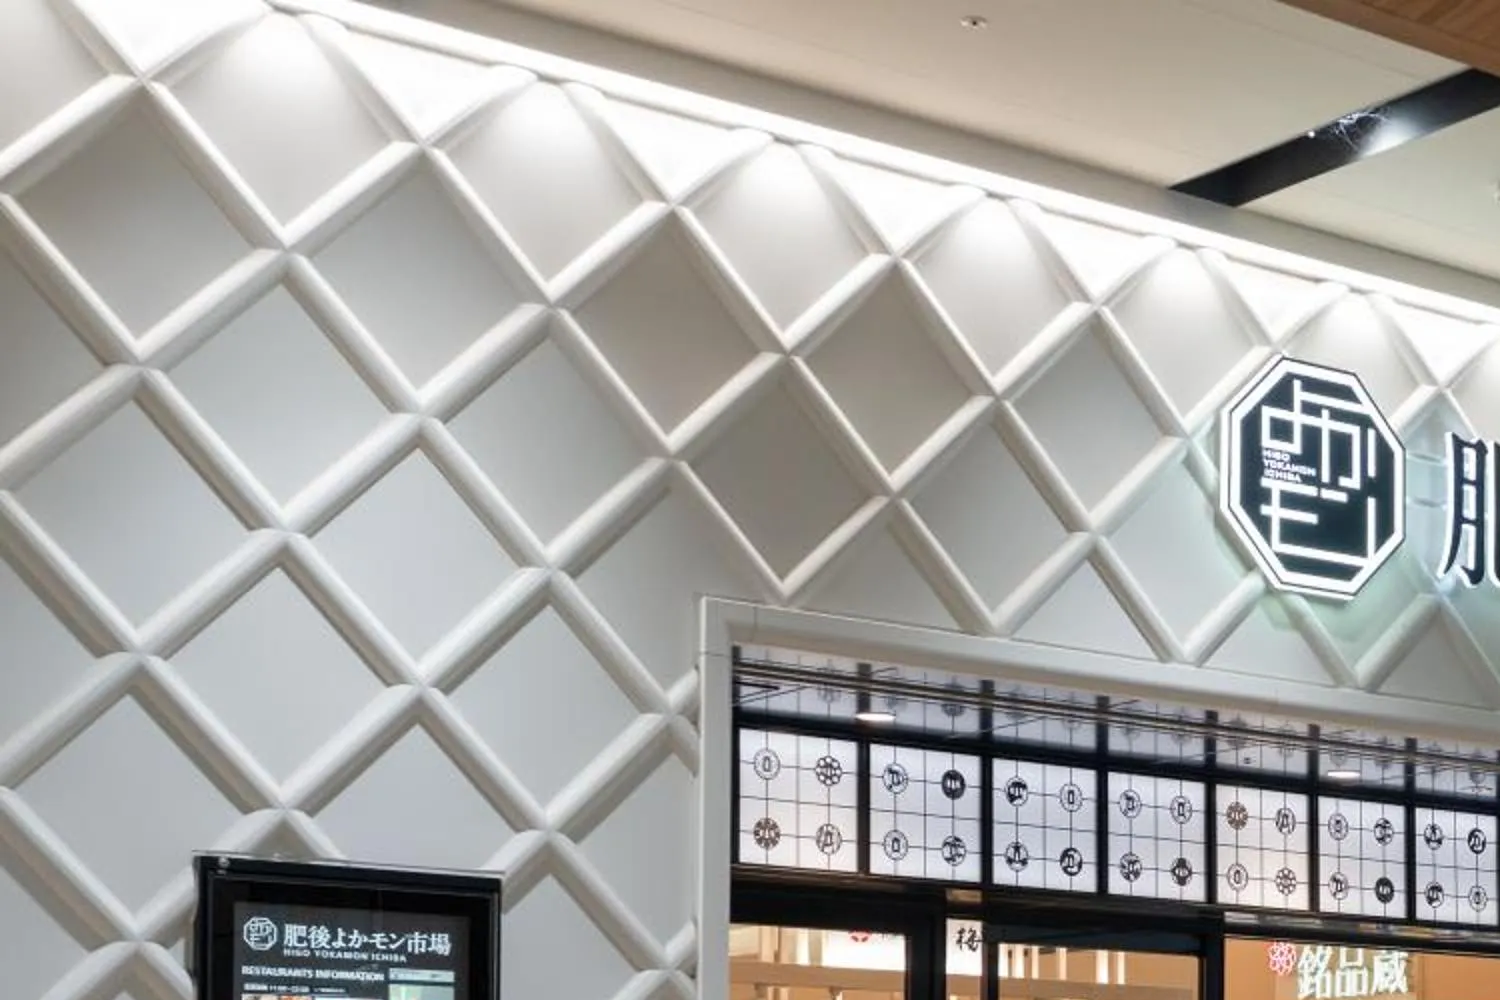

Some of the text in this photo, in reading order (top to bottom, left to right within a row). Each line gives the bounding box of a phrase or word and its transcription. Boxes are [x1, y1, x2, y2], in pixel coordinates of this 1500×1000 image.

[284, 923, 452, 956] 肥後よかモン市場
